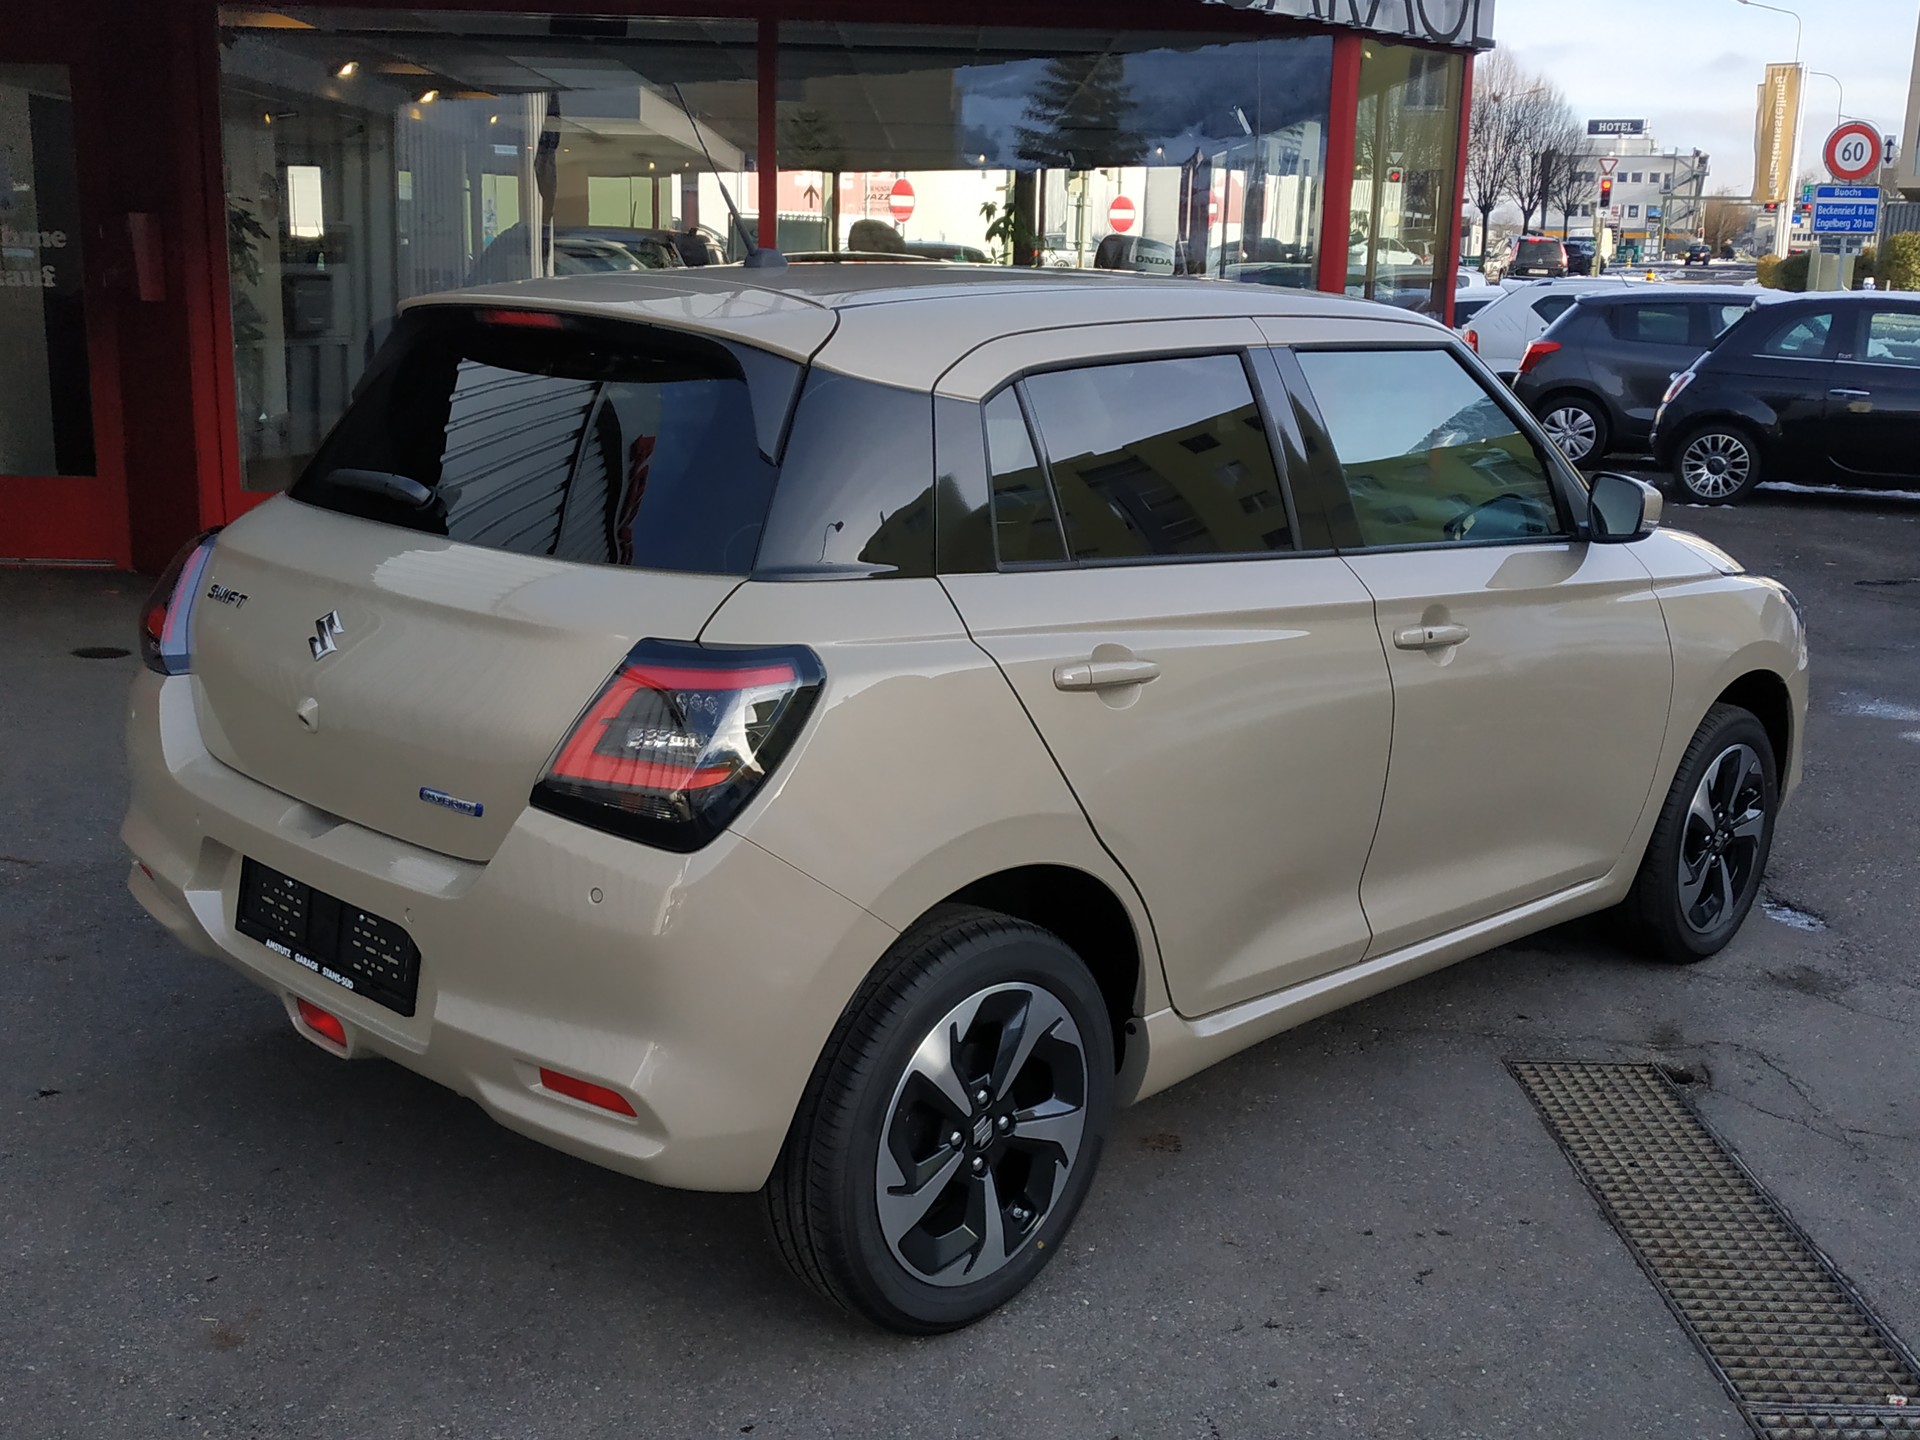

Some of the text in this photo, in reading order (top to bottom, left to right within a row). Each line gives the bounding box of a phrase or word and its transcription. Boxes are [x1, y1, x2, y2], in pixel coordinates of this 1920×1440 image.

[1598, 122, 1633, 132] HOTEL
[1842, 142, 1864, 161] 60
[1834, 188, 1862, 197] Buochs
[1817, 205, 1875, 215] Beckenried 8 km
[1816, 219, 1873, 230] Engelberg 20 km
[207, 584, 248, 608] SWIFT
[424, 790, 473, 812] HYBRID
[265, 939, 292, 958] AMSTUTZ
[294, 953, 319, 972] GARAGE
